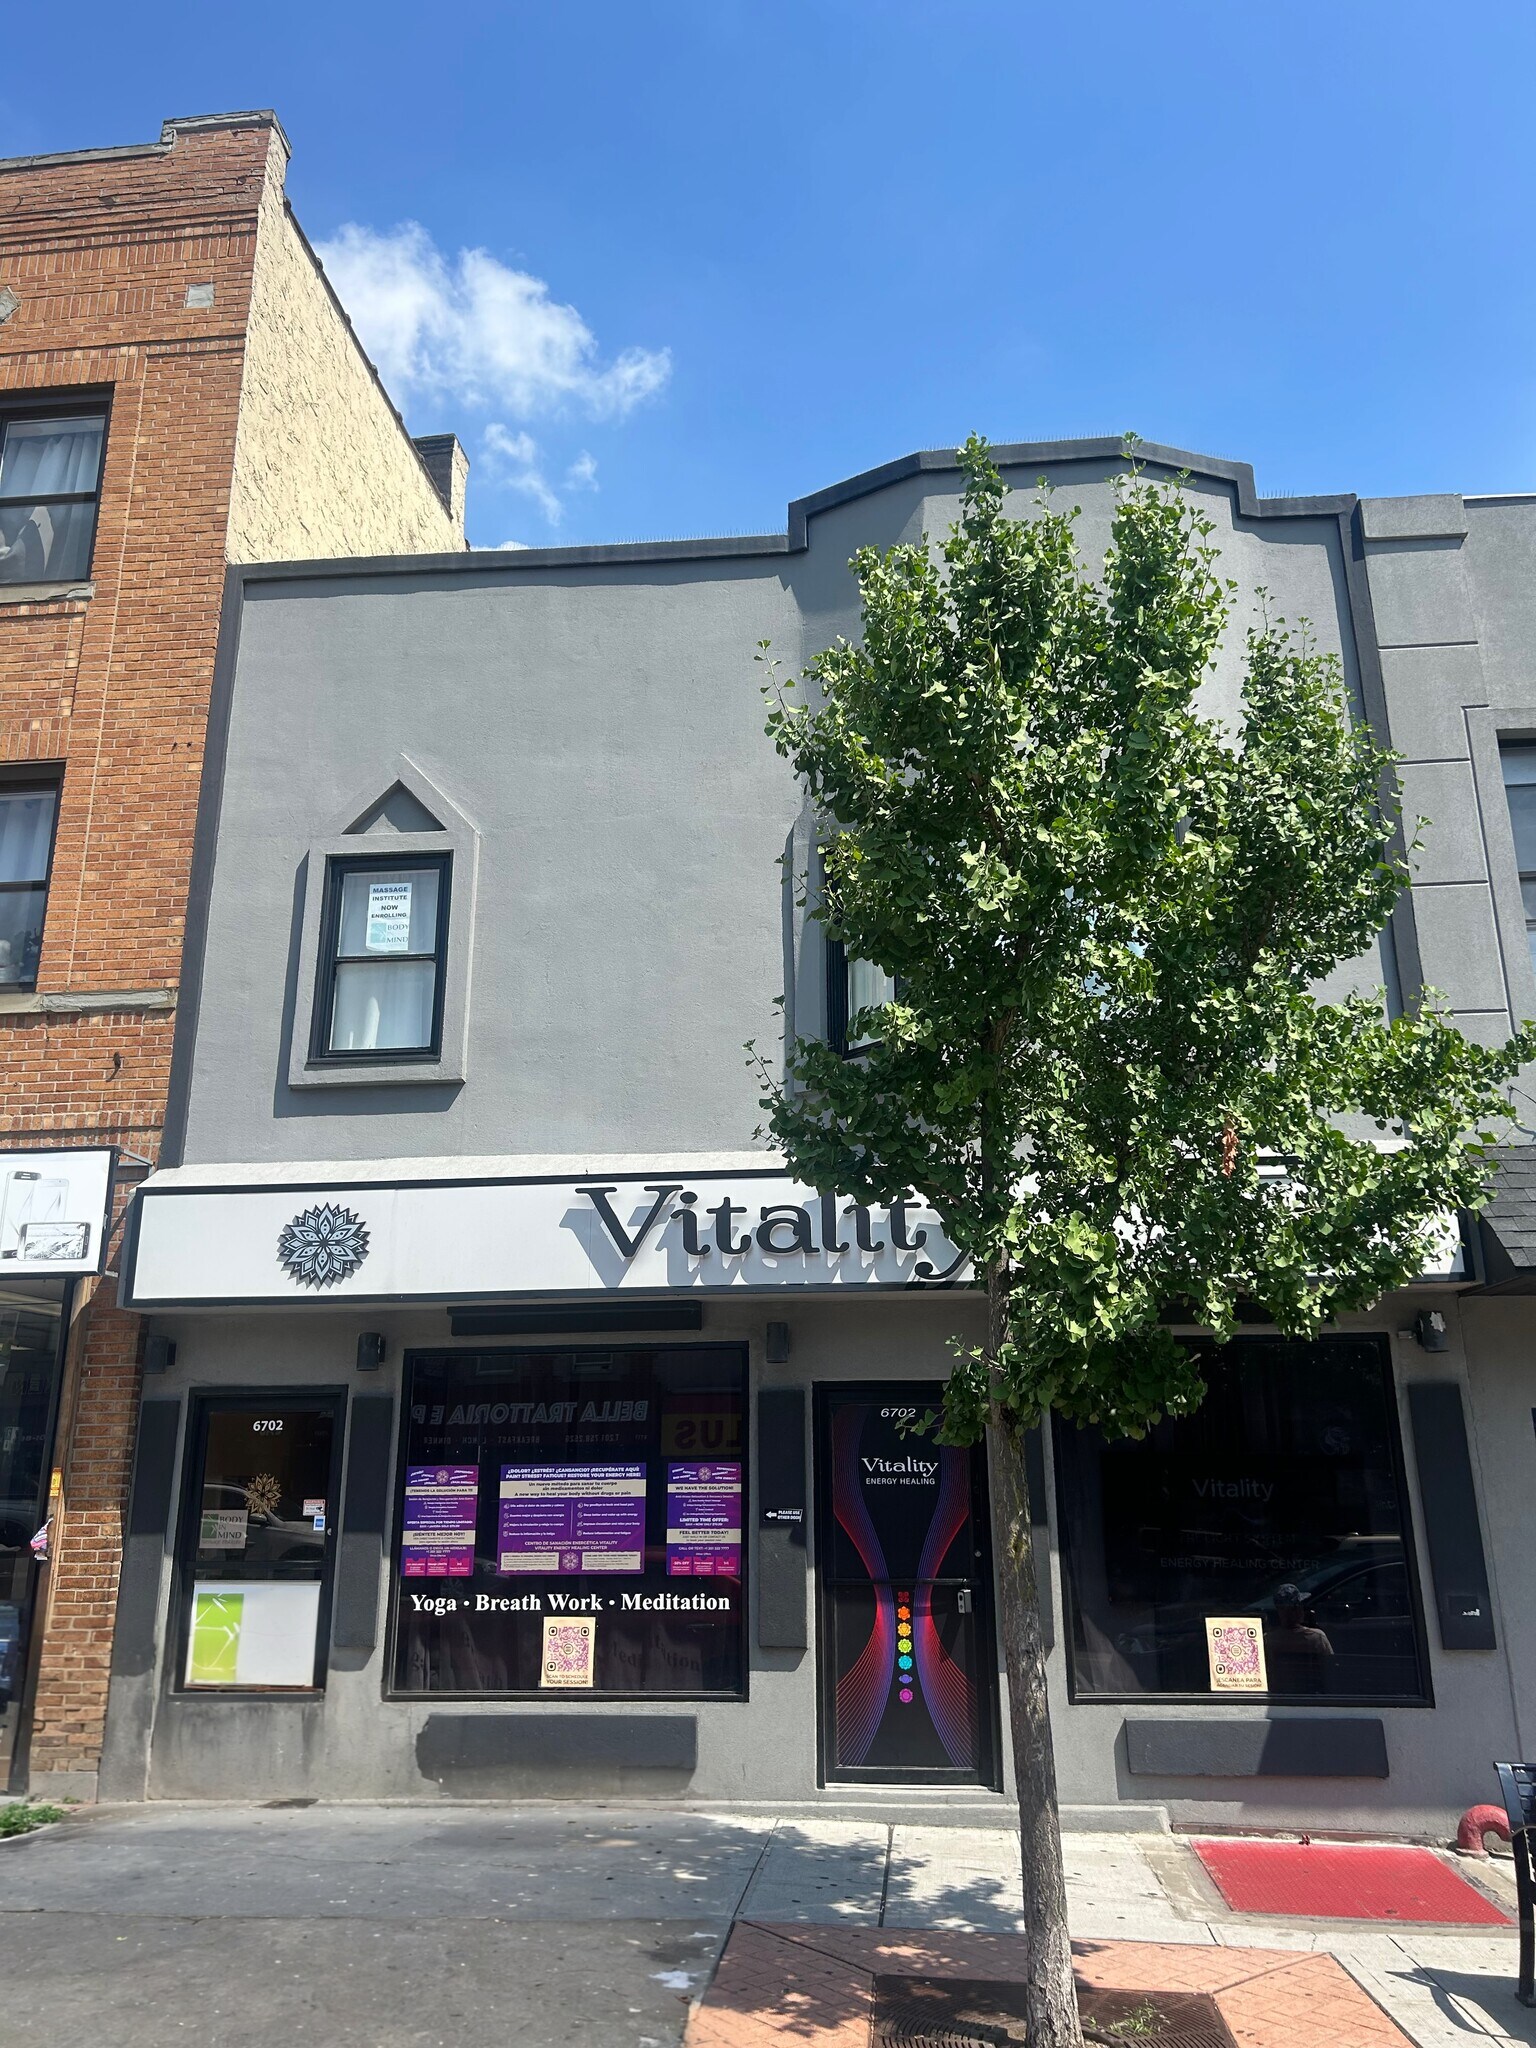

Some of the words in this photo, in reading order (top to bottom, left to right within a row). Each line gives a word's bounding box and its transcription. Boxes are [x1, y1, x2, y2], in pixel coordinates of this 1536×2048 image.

[881, 1408, 916, 1418] 6702
[253, 1420, 283, 1431] 6702
[861, 1456, 939, 1477] Vitality
[1192, 1478, 1274, 1502] Vitality
[1160, 1558, 1208, 1568] ENERGY
[1214, 1558, 1267, 1569] HEALING
[1270, 1559, 1320, 1569] CENTER
[410, 1594, 457, 1616] Yoga
[475, 1594, 541, 1611] Breath
[547, 1593, 603, 1610] Work
[621, 1593, 730, 1610] Meditation
